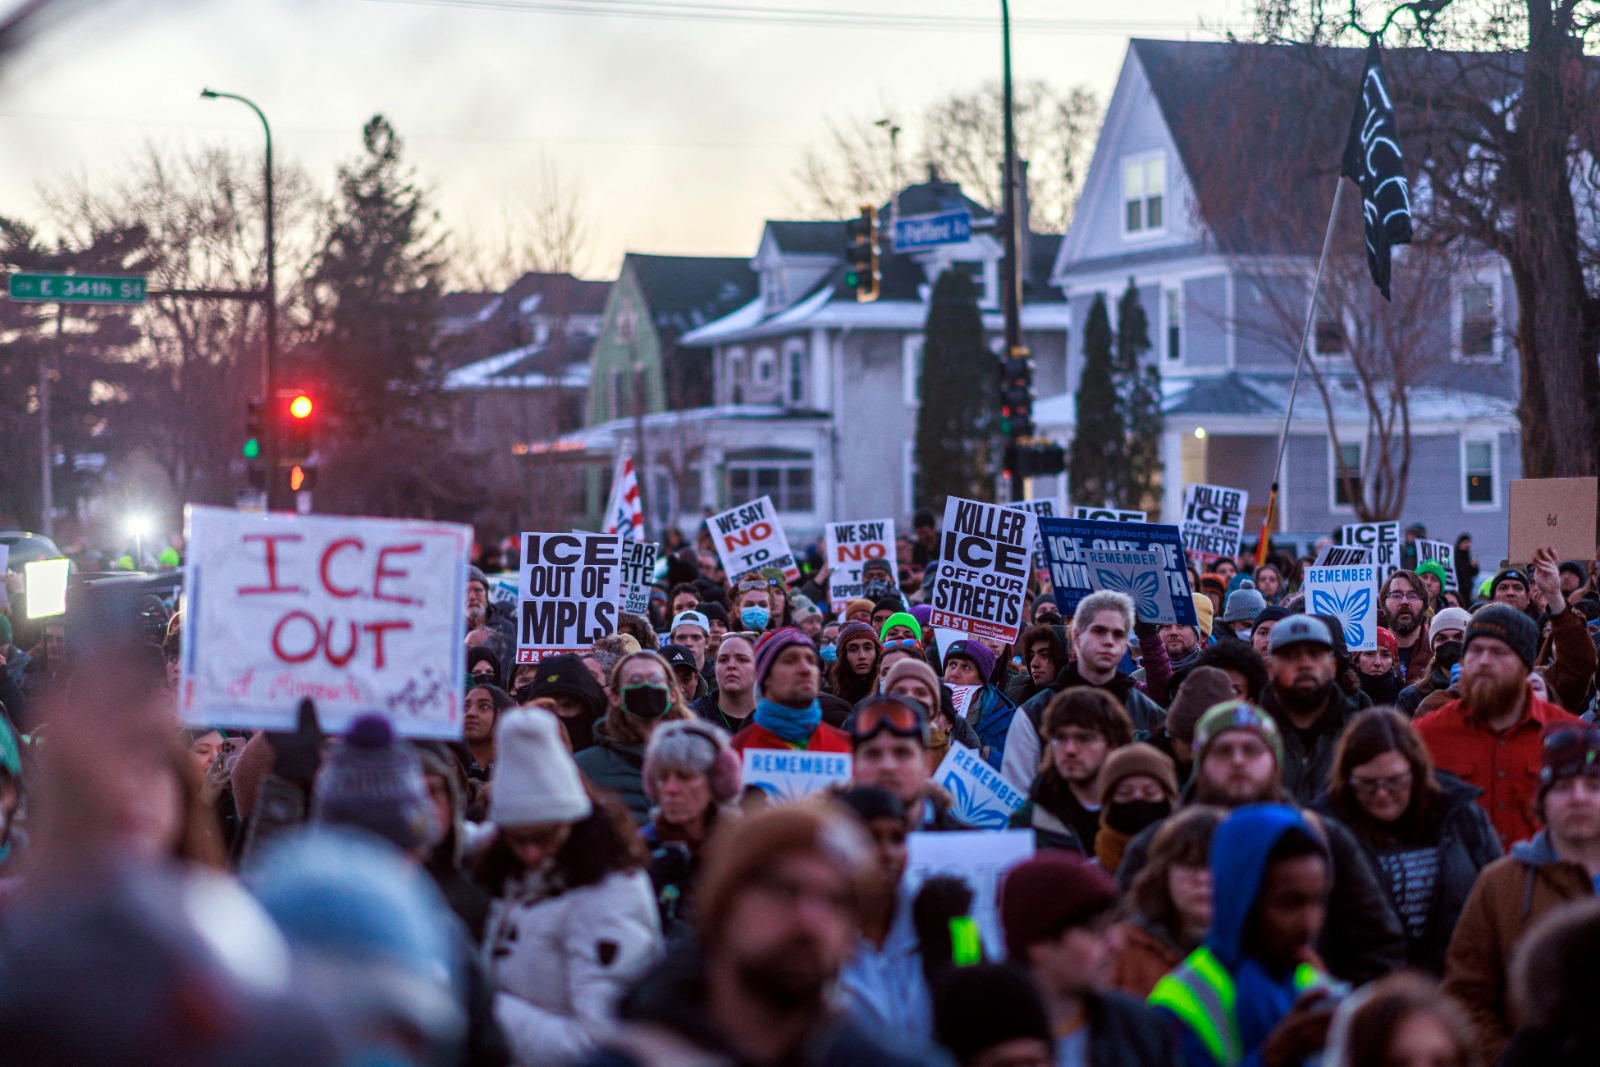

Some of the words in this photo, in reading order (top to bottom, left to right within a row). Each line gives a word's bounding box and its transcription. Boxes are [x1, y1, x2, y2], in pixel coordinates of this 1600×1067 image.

[40, 279, 53, 296] E
[62, 280, 112, 297] 34th
[120, 281, 141, 298] St
[1194, 486, 1240, 511] KILLER
[715, 512, 740, 534] WE
[739, 502, 765, 525] SAY
[953, 500, 1026, 546] KILLER
[1186, 504, 1241, 529] ICE
[723, 522, 772, 553] NO
[835, 525, 856, 543] WE
[859, 522, 884, 541] SAY
[1041, 524, 1072, 534] Leave
[1073, 527, 1091, 535] our
[1094, 529, 1148, 540] neighbors
[1149, 532, 1180, 541] alone
[1181, 530, 1238, 557] STREETS
[1346, 523, 1397, 545] ICE
[527, 535, 619, 565] ICE
[741, 548, 769, 566] TO
[837, 543, 886, 562] NO
[944, 531, 1027, 578] ICE
[1048, 535, 1086, 563] ICE
[1090, 552, 1158, 566] REMEMBER
[1377, 544, 1394, 565] OF
[529, 566, 575, 598] OUT
[581, 566, 611, 598] OF
[848, 569, 861, 581] T
[941, 565, 980, 582] OFF
[981, 574, 1024, 593] OUR
[1310, 567, 1373, 583] REMEMBER
[629, 592, 646, 602] OUR
[631, 585, 640, 593] IN
[935, 578, 1020, 625] STREETS
[625, 600, 647, 612] STATE
[521, 600, 615, 645] MPLS
[271, 610, 412, 670] OUT
[752, 754, 846, 775] REMEMBER
[953, 749, 1025, 809] REMEMBER
